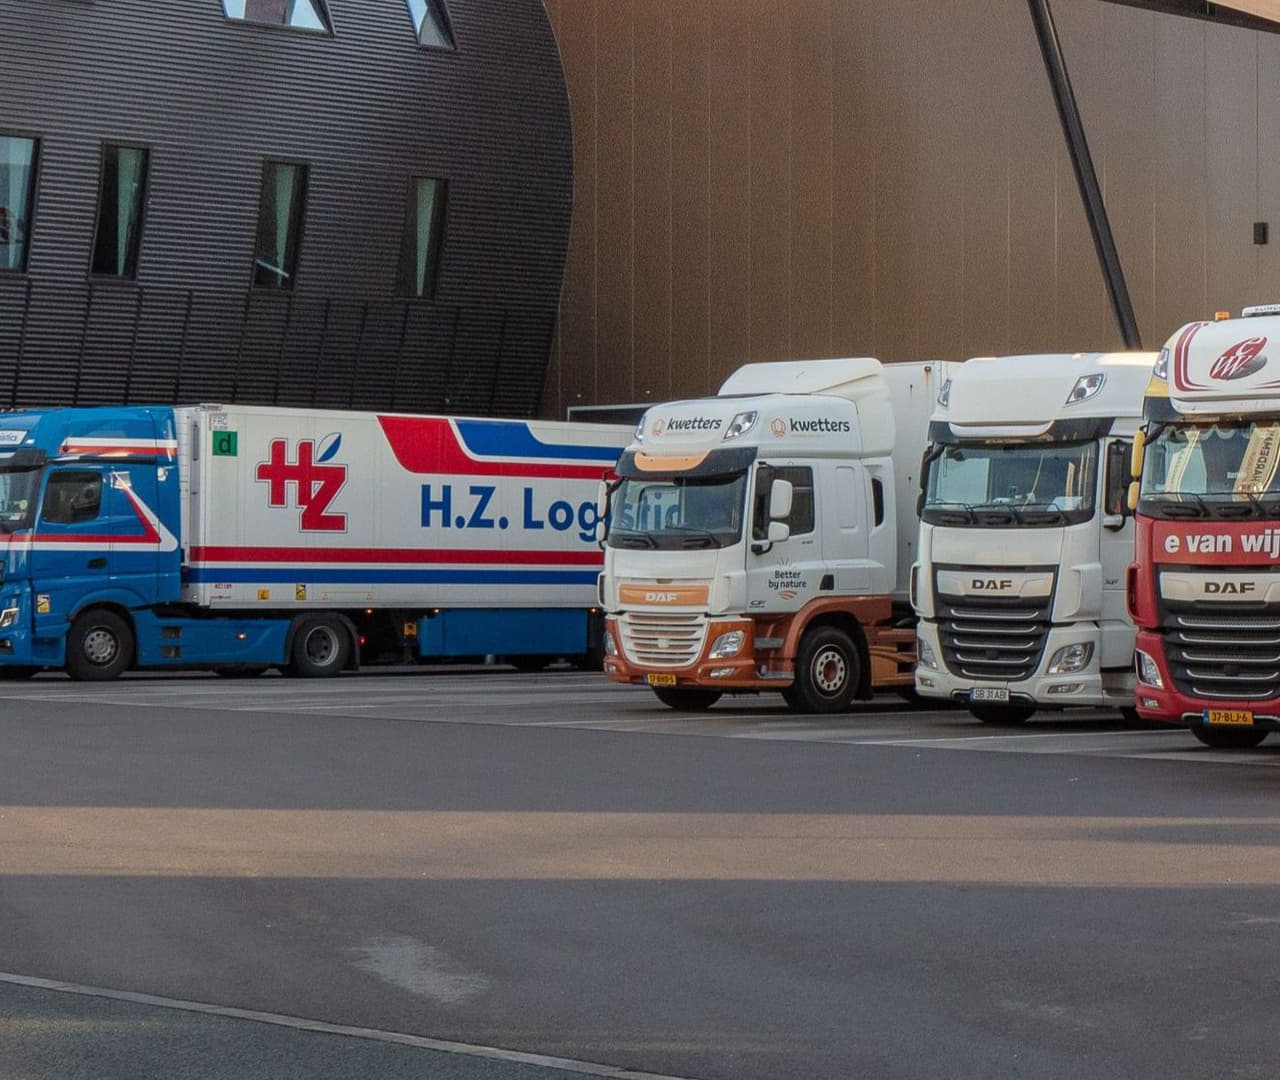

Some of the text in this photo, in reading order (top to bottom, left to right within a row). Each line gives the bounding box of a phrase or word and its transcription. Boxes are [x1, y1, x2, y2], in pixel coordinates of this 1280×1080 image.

[666, 418, 722, 431] kwetters
[790, 417, 850, 433] kwetters
[219, 433, 232, 454] d
[256, 437, 348, 534] HZ
[420, 483, 510, 530] H.Z.
[1164, 534, 1180, 554] e
[1186, 533, 1233, 553] van
[774, 570, 801, 580] Better
[768, 579, 807, 590] by nature
[971, 579, 1014, 590] DAF
[1203, 581, 1256, 594] DAF
[644, 592, 678, 602] DAF
